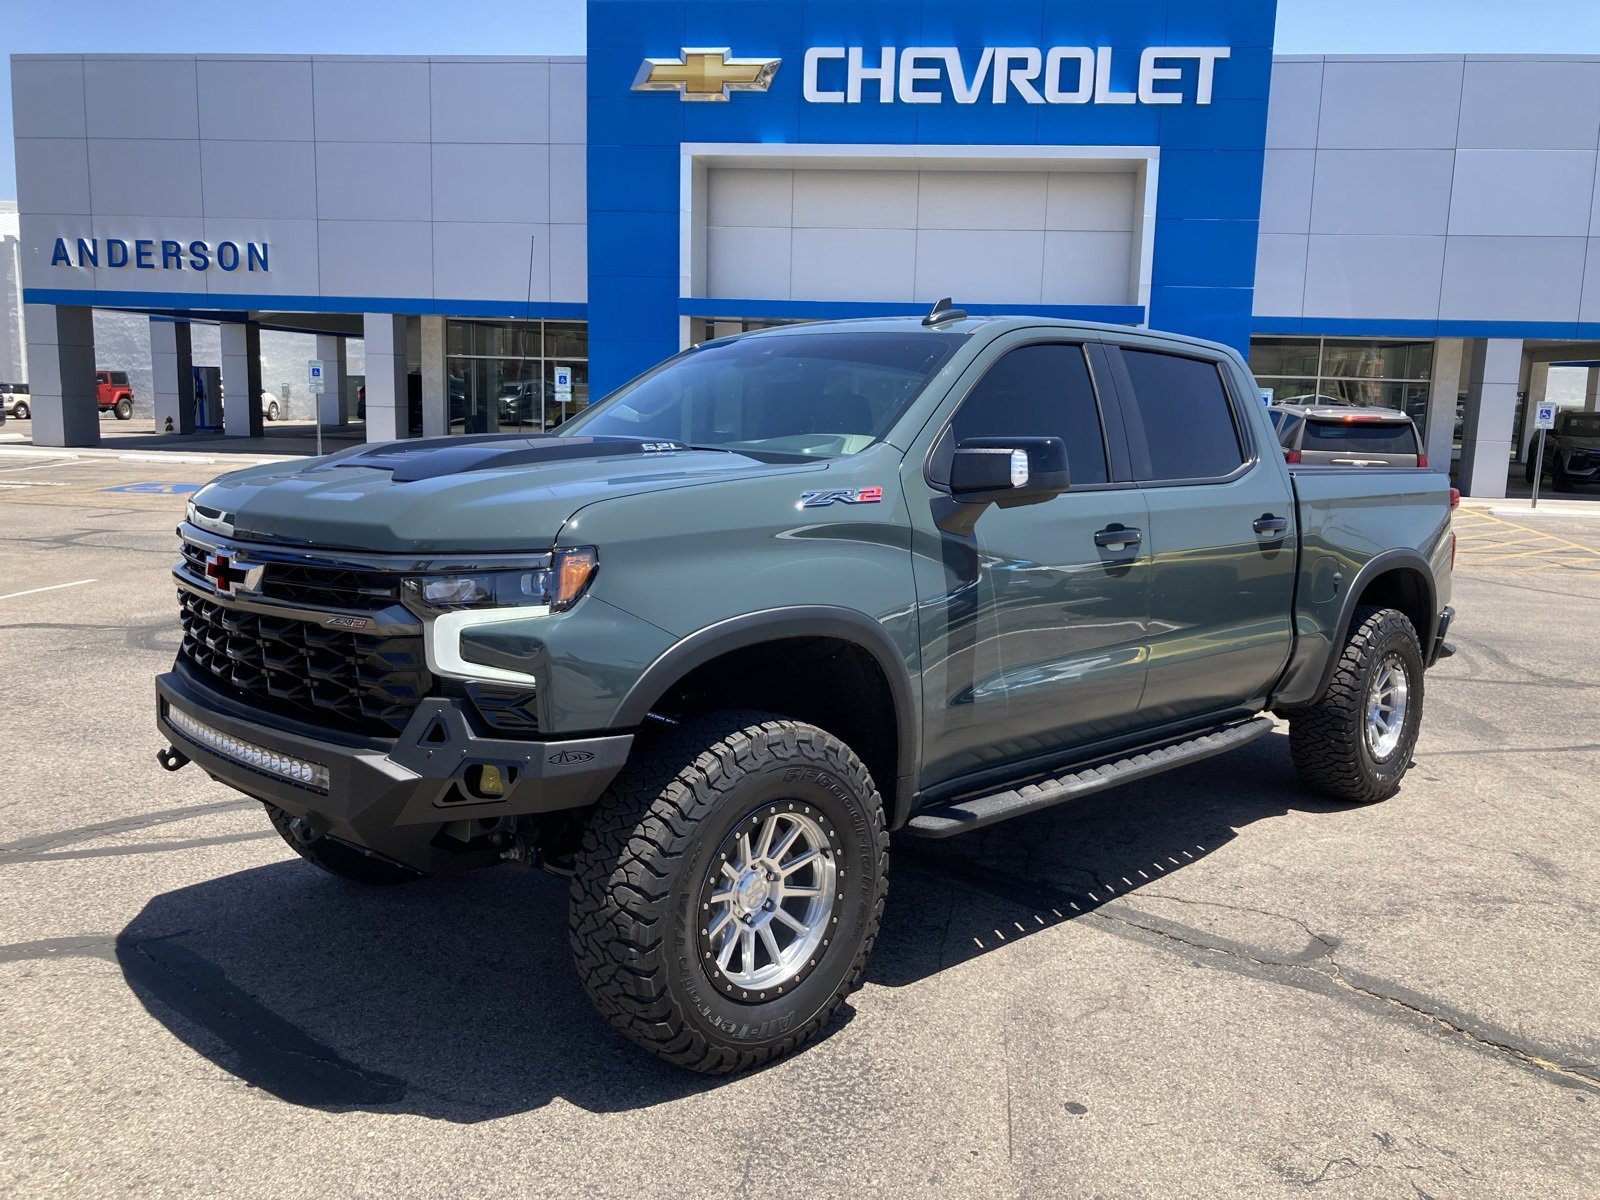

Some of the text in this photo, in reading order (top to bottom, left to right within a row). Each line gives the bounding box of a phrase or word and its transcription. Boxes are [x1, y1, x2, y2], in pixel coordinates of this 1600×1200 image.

[803, 46, 1231, 105] CHEVROLET
[51, 238, 269, 272] ANDERSON
[796, 487, 882, 508] ZR2
